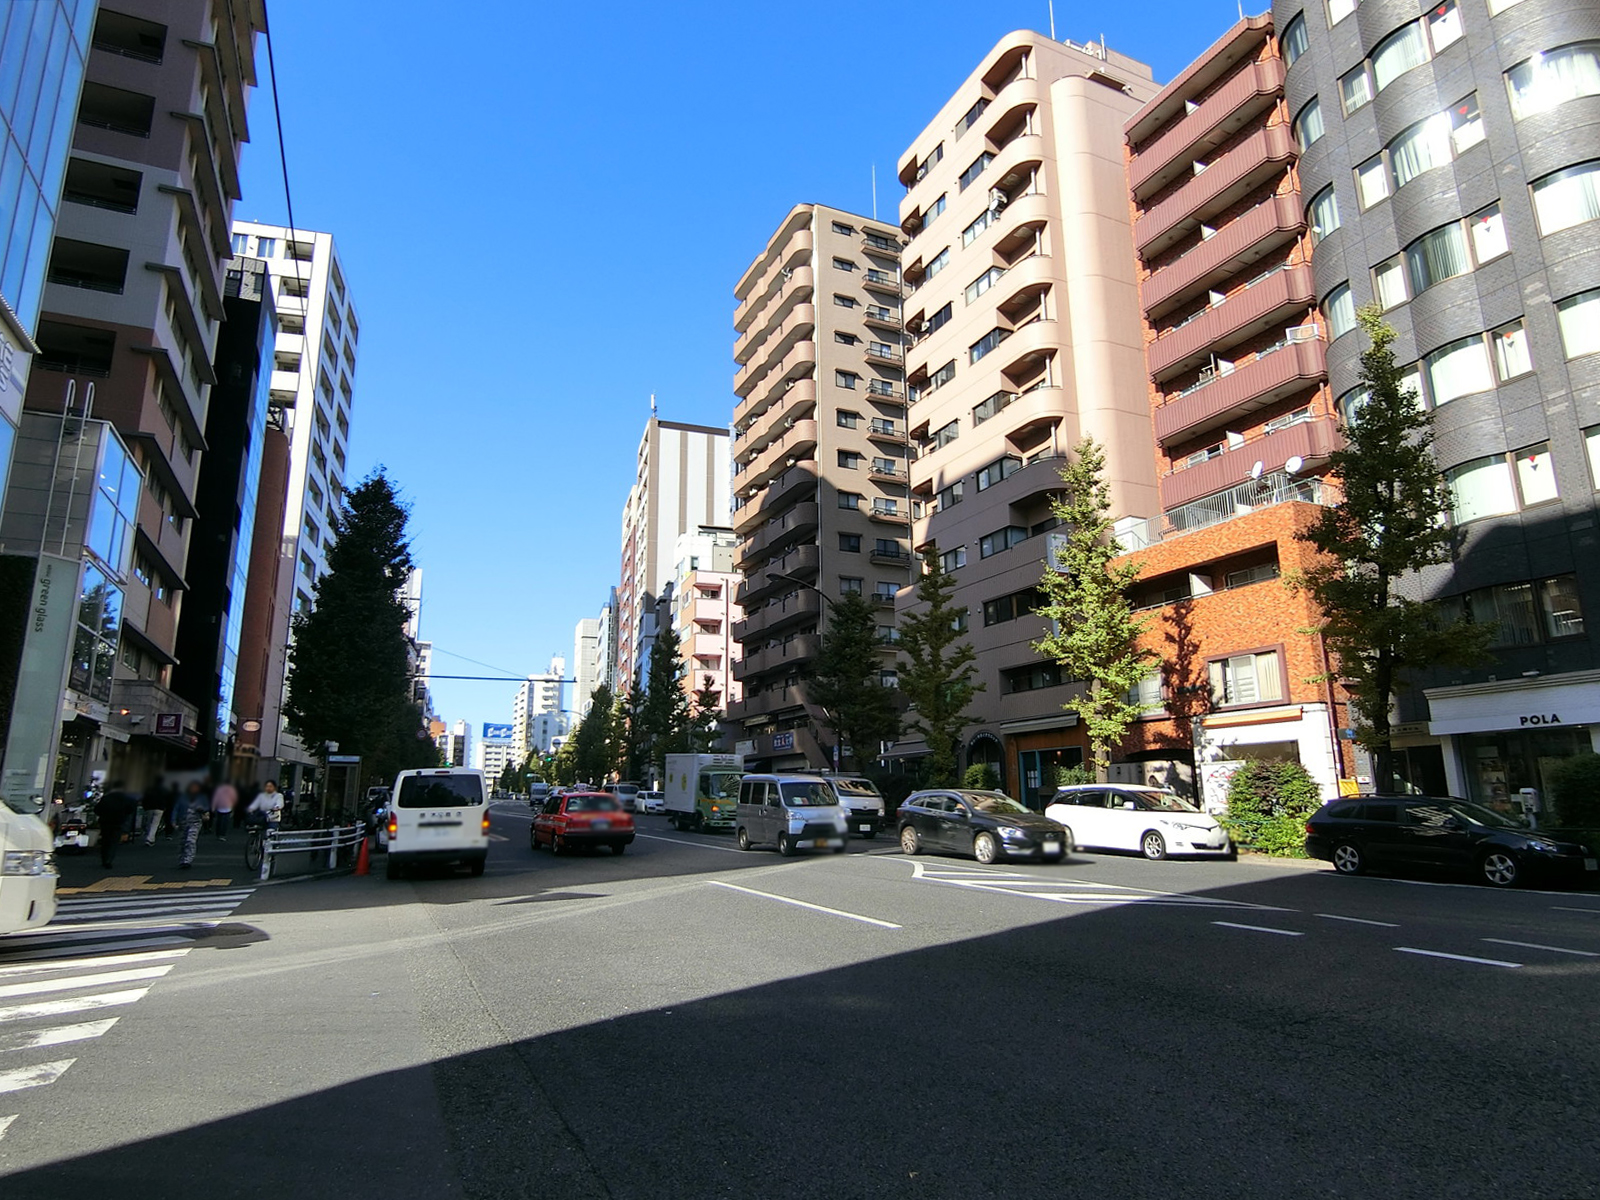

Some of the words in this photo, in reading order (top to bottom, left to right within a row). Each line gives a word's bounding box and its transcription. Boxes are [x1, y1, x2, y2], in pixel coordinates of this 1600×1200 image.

[39, 578, 51, 606] green
[34, 607, 48, 633] glass
[1519, 713, 1561, 726] POLA
